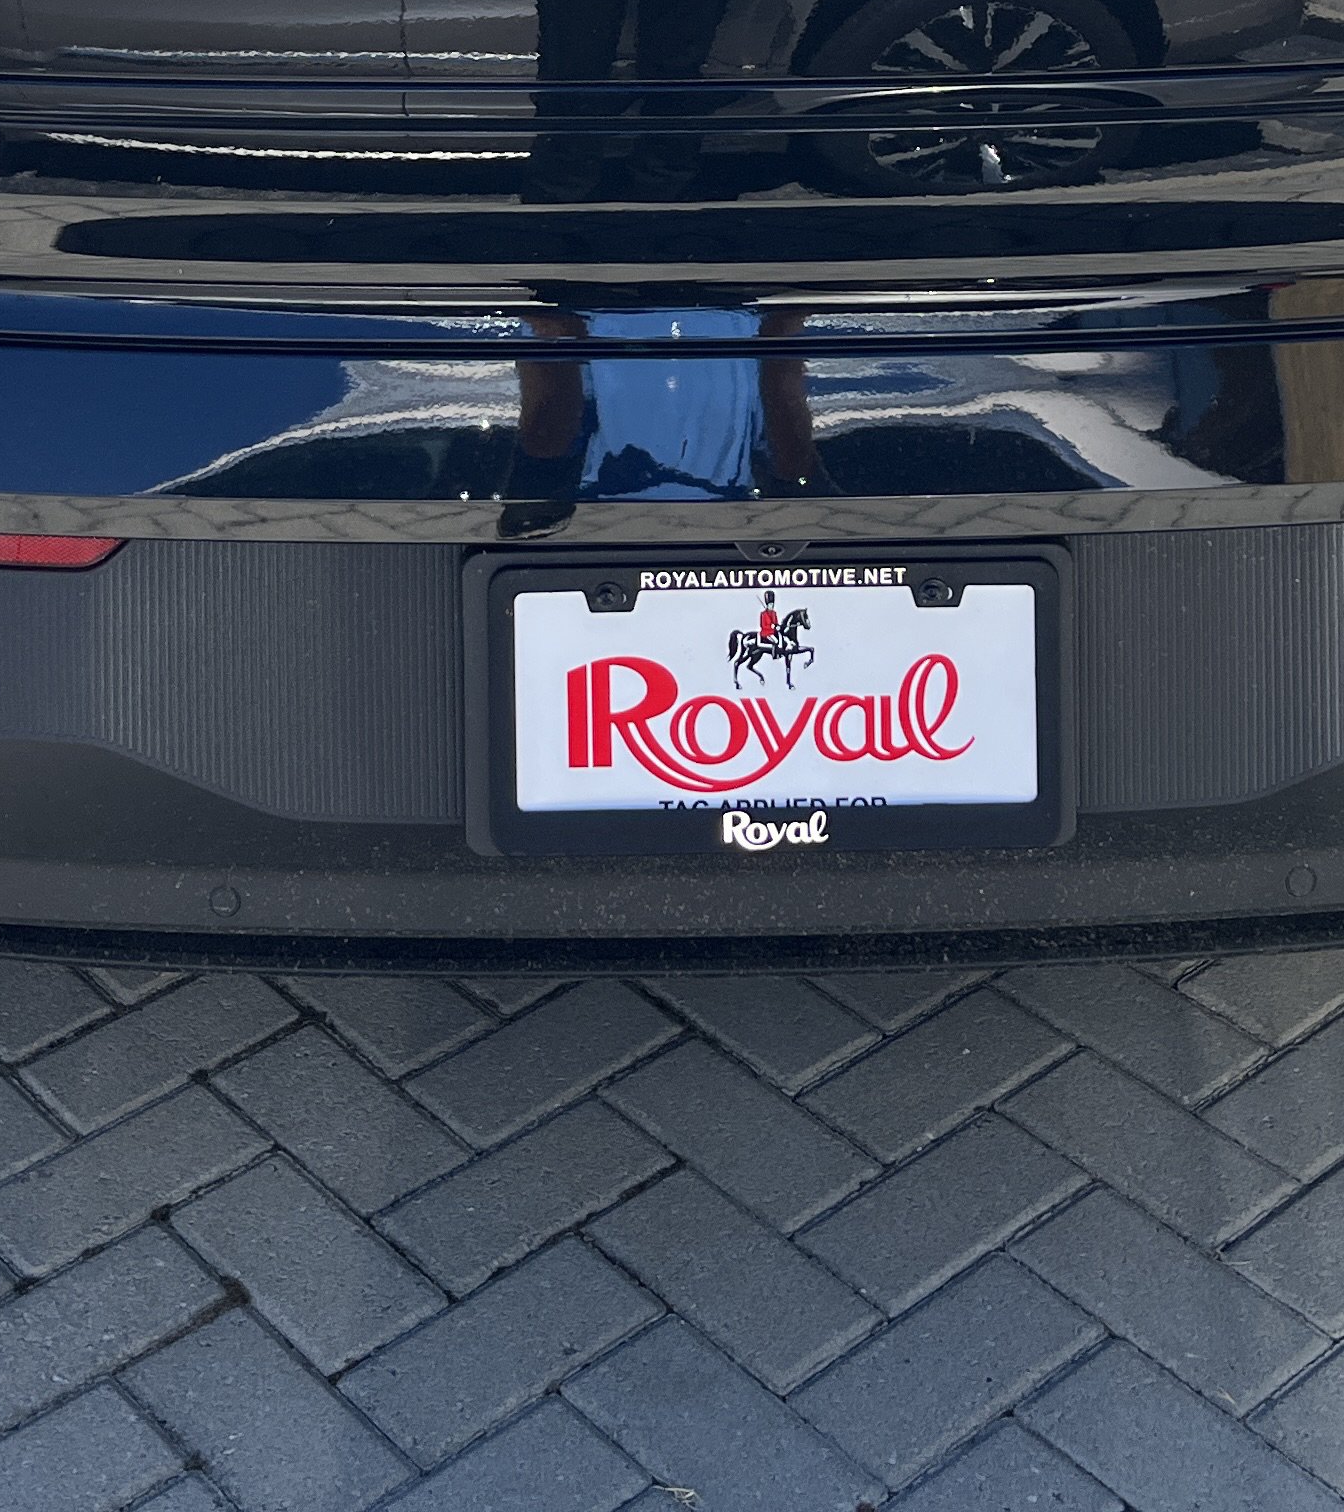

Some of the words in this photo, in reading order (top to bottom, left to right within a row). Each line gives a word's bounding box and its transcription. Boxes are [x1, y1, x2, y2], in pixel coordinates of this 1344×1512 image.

[640, 567, 907, 589] ROYALAUTOMOTIVE.NET
[567, 653, 975, 792] Royal
[722, 810, 829, 851] Royal
